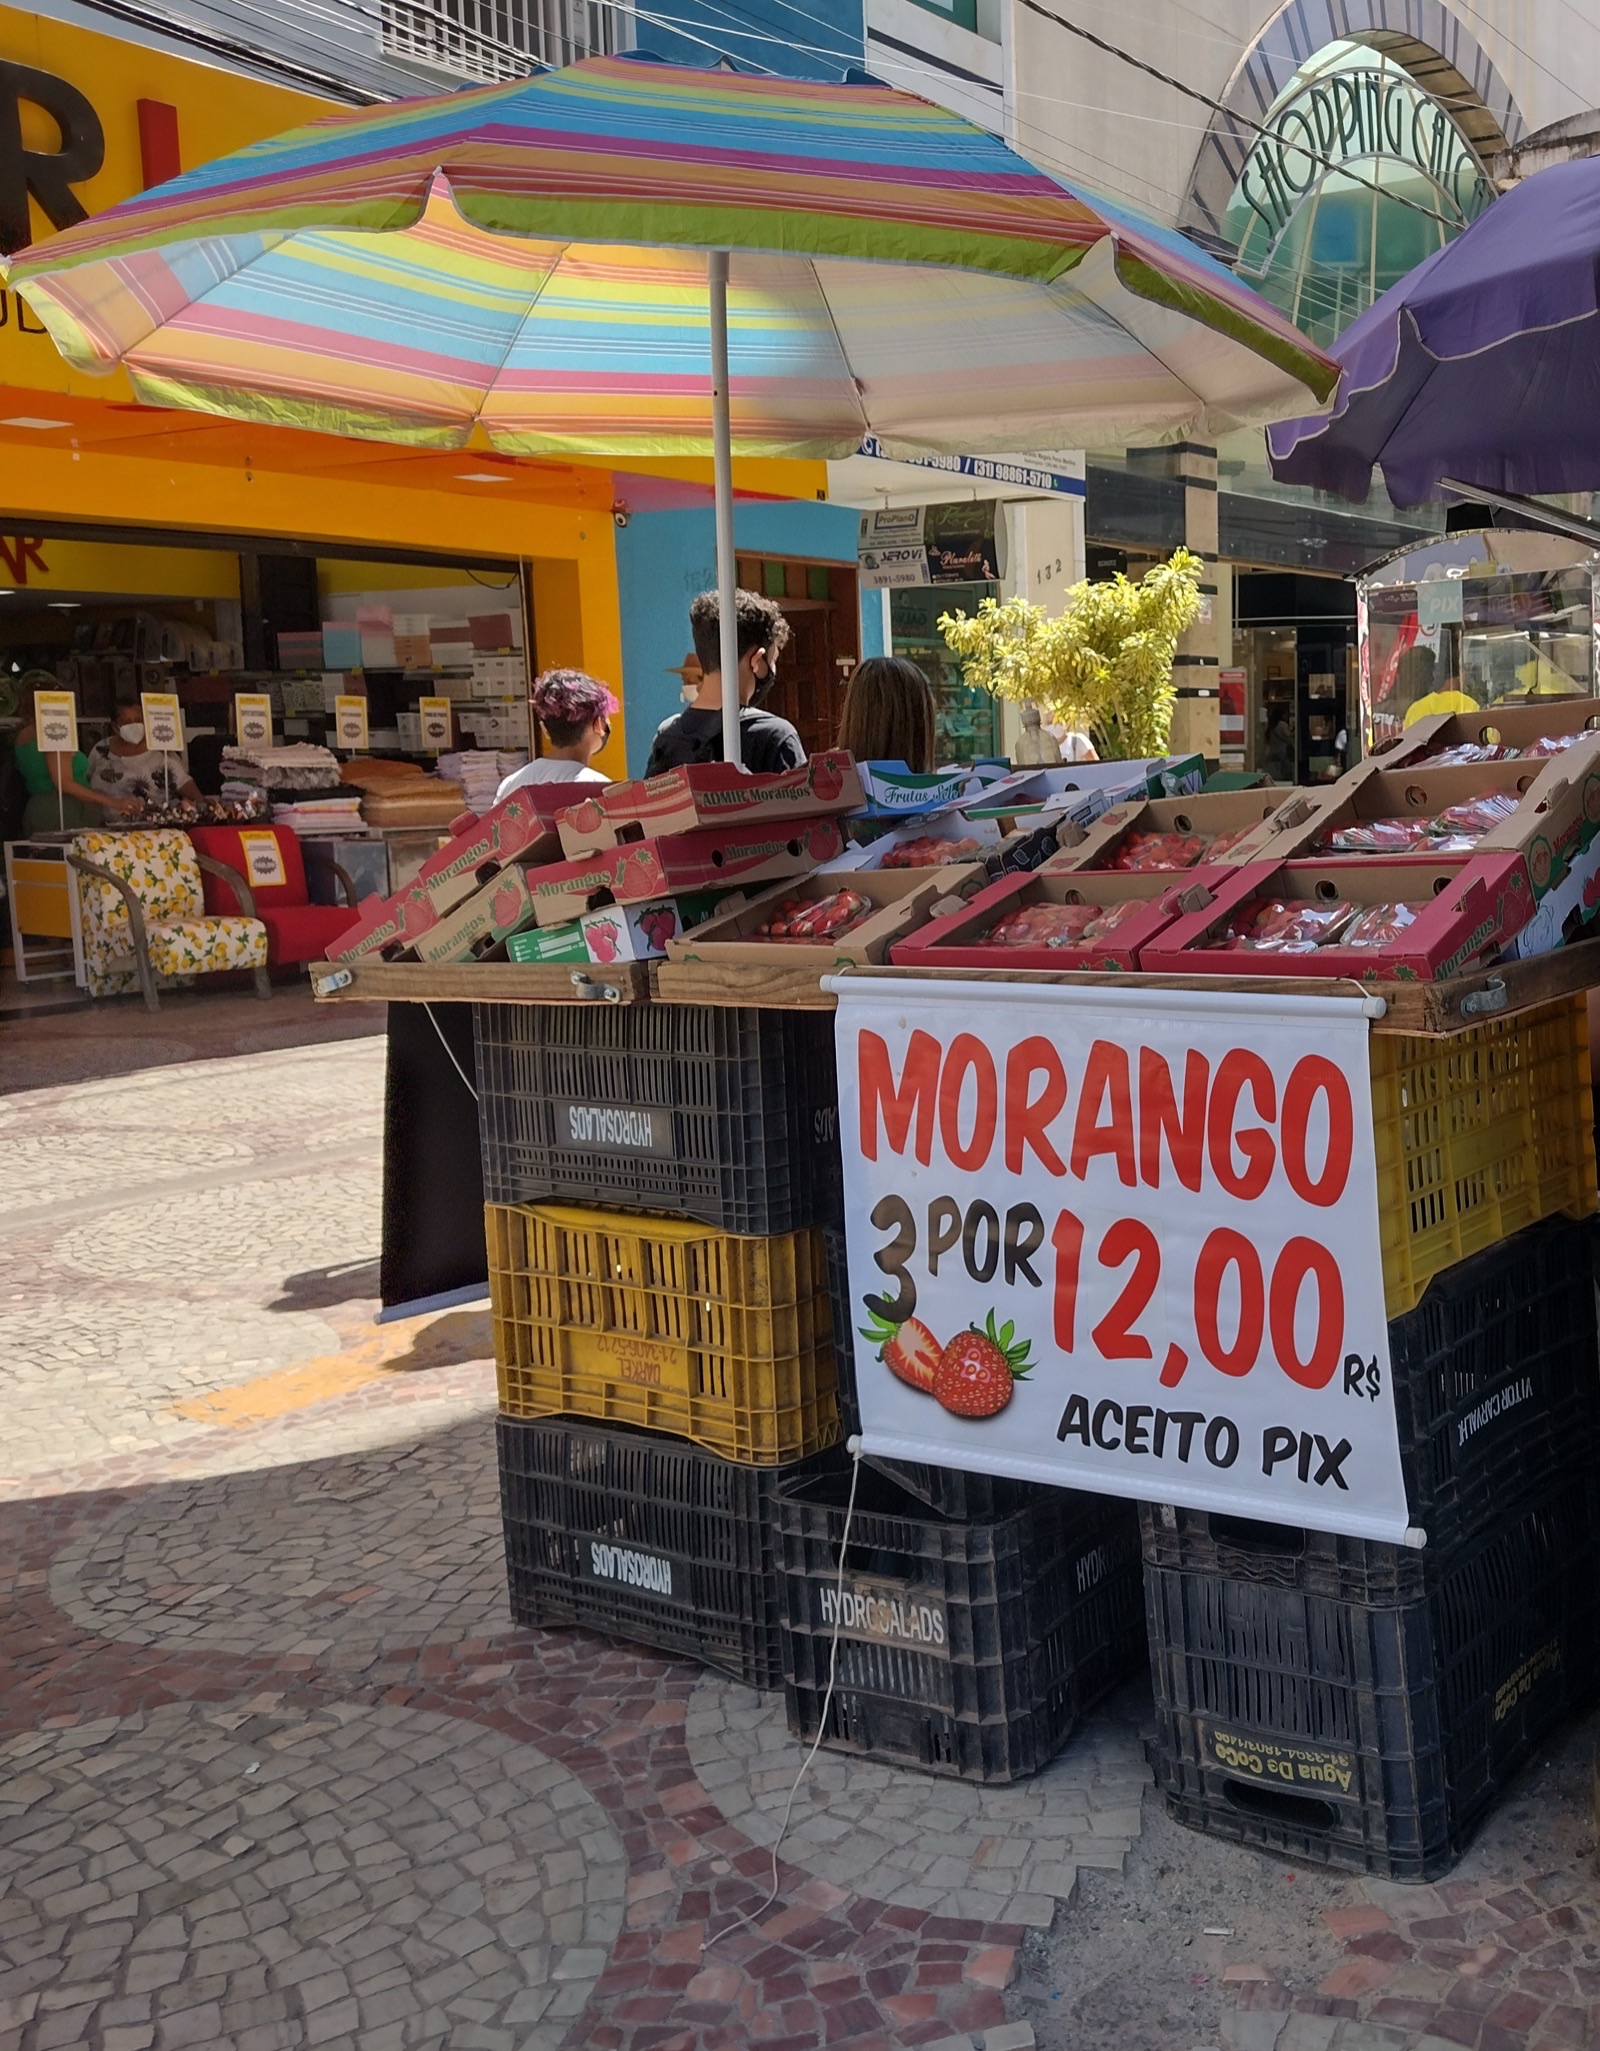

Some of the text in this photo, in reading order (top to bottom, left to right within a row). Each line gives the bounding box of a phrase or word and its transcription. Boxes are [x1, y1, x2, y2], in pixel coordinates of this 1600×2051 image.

[1241, 71, 1403, 254] SHOPPING
[973, 459, 994, 478] (31)
[995, 464, 1052, 489] 98861-5710
[873, 574, 916, 585] 3891-5980
[1037, 558, 1062, 584] 132
[1427, 593, 1459, 613] PIX
[701, 785, 811, 808] ADMIR Morangos
[884, 784, 961, 804] Frutas Sele
[427, 838, 490, 891] Morangos
[726, 841, 787, 858] Morangos
[536, 870, 612, 898] Morangos
[338, 919, 396, 964] Morangos
[428, 913, 486, 963] Morangos
[1433, 916, 1495, 981] Morangos
[569, 1105, 652, 1148] HYDROSALADS
[858, 1028, 1354, 1207] MORANGO
[863, 1194, 1381, 1402] 3 POR 12,00 R$
[616, 1356, 661, 1384] DARKEL
[1501, 1377, 1534, 1411] VITOR
[1057, 1394, 1352, 1491] ACEITO PIX
[591, 1541, 672, 1595] HYDROSALADS
[1267, 1758, 1294, 1781] De
